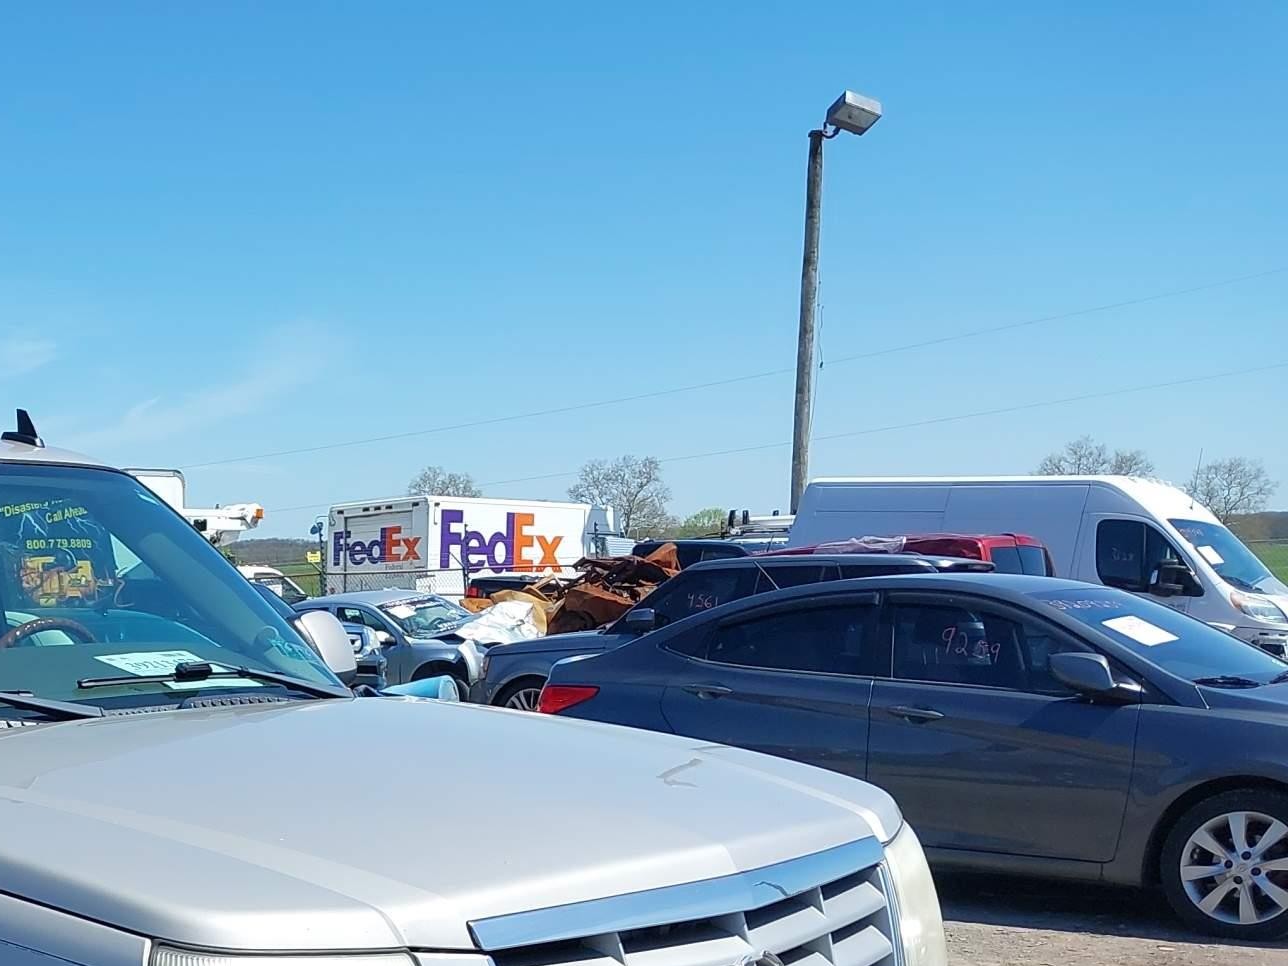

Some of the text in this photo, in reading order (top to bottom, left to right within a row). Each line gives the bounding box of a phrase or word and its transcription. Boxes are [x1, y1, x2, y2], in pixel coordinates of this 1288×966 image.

[45, 510, 65, 523] Call
[333, 525, 422, 567] FedEx
[440, 508, 565, 575] FedEx
